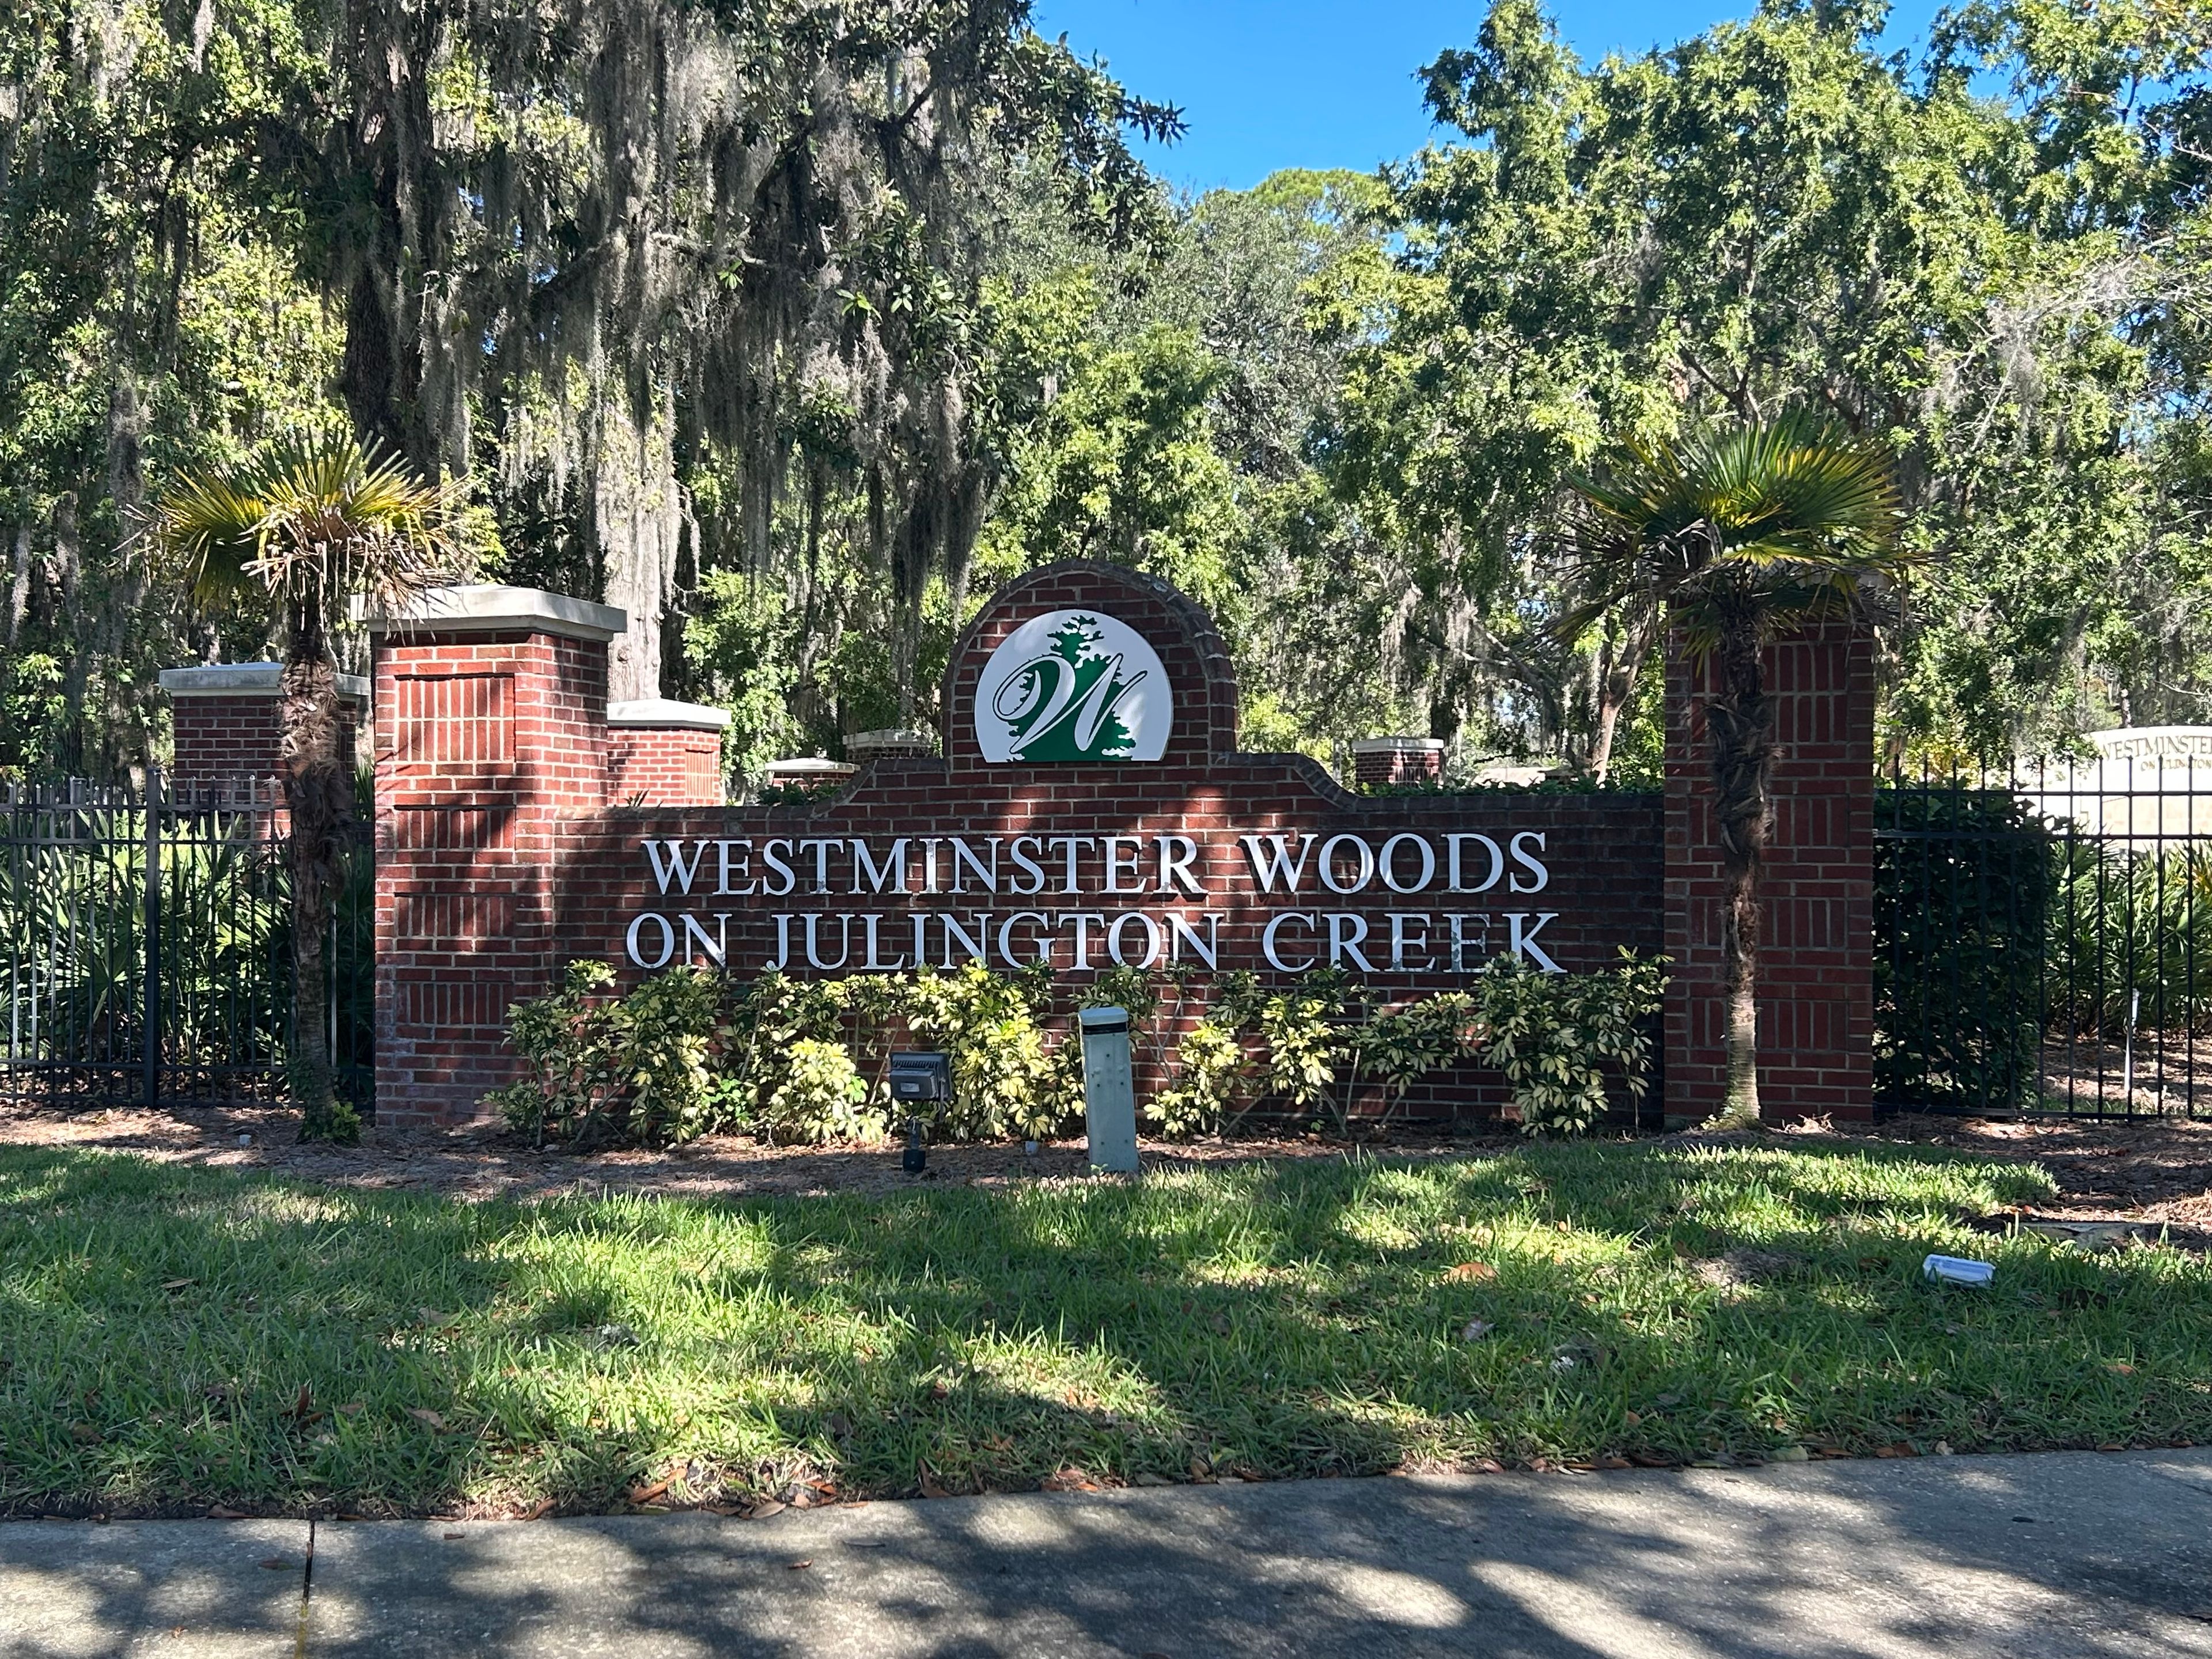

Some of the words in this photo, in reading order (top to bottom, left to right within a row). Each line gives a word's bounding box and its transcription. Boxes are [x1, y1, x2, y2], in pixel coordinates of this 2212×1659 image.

[992, 652, 1148, 753] W
[2101, 735, 2212, 761] WESTMINSTE
[641, 835, 1209, 895] WESTMINSTER
[1238, 831, 1549, 895] WOODS
[626, 912, 733, 969] ON
[766, 912, 1224, 971] JULINGTON
[1263, 912, 1568, 974] CREEK
